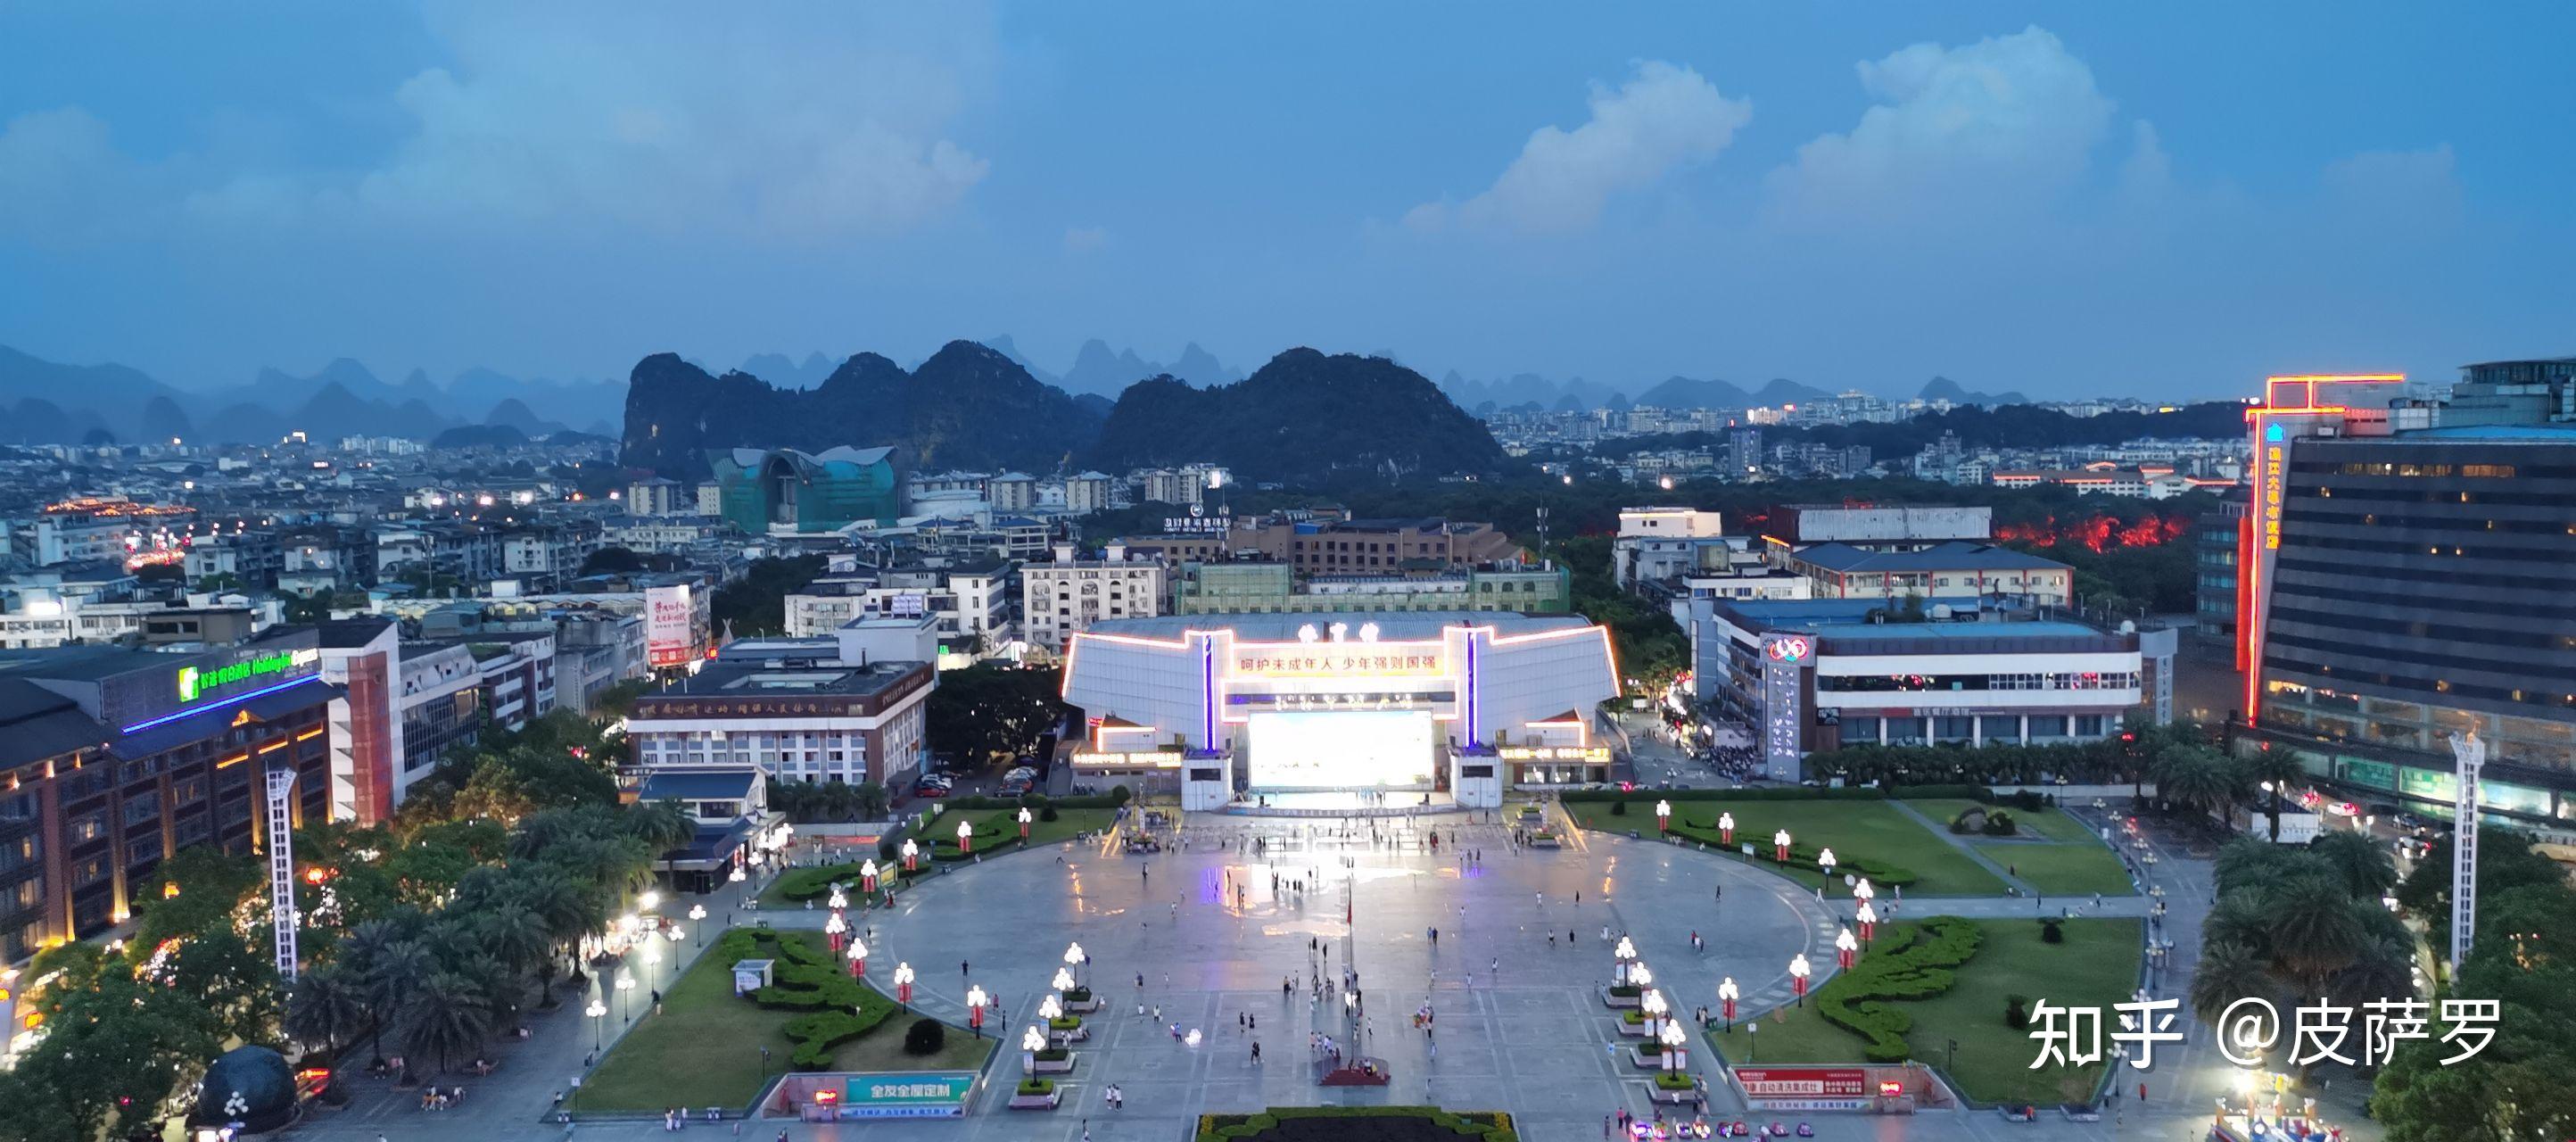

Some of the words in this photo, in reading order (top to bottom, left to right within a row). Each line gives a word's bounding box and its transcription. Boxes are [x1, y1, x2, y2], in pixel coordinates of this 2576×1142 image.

[1241, 658, 1333, 671] 呵护未成年人
[1342, 656, 1436, 670] 少年强则国强
[871, 1084, 951, 1098] 全友全屋定制
